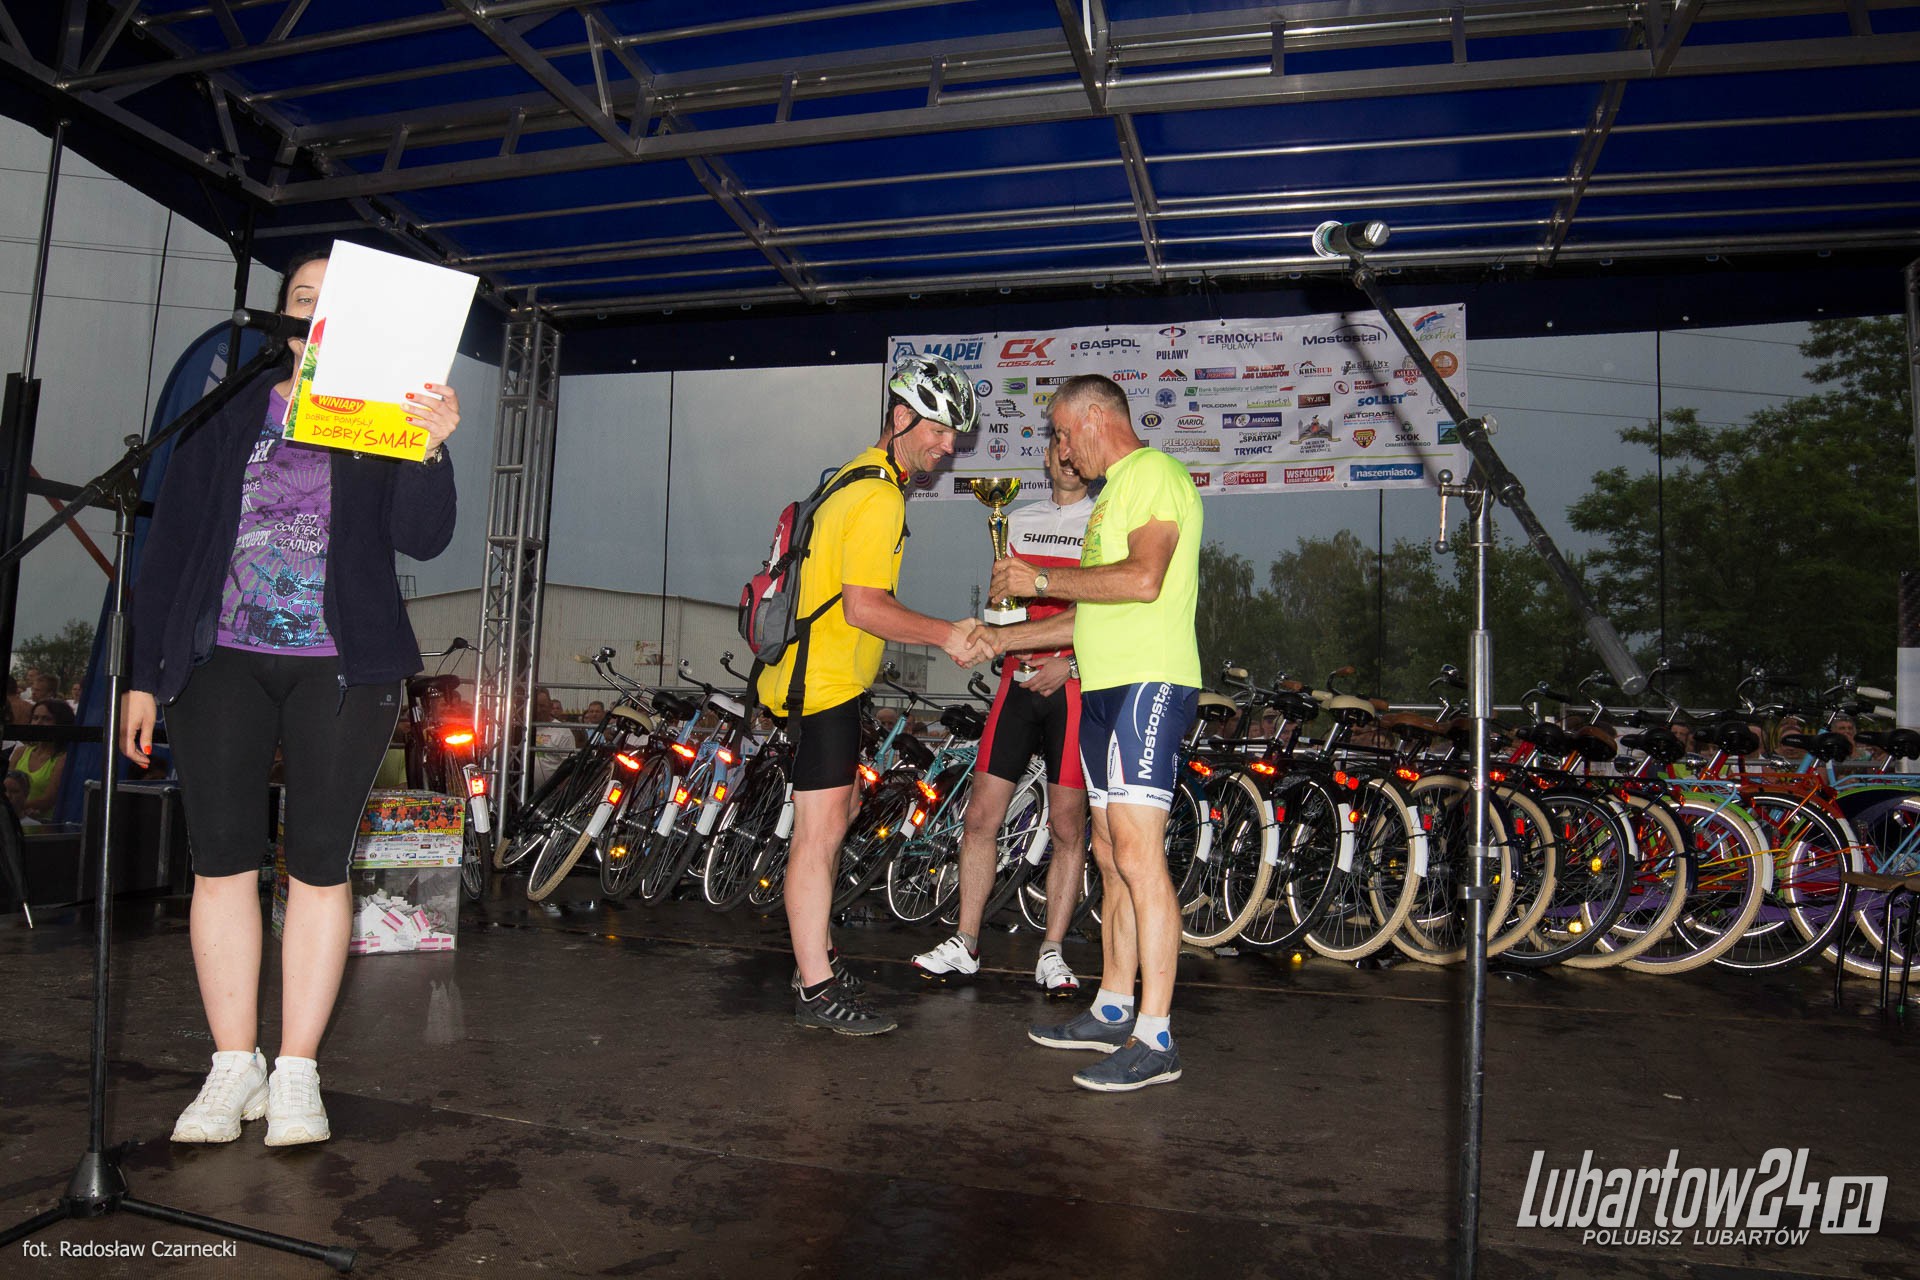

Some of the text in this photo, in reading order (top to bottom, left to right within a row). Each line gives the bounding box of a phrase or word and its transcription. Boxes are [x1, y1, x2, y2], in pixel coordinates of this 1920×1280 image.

[1198, 331, 1284, 345] TERMOCHEM
[1302, 331, 1381, 346] Mostostal
[1080, 338, 1141, 350] GASPOL
[1221, 341, 1257, 351] PUŁAWY
[923, 341, 983, 362] MAPEI
[1156, 349, 1189, 361] PUŁAWY
[996, 359, 1056, 368] COSSACK
[1048, 376, 1070, 385] SATUR
[1112, 369, 1148, 382] OLIMP
[318, 395, 364, 411] WINIARY
[1357, 394, 1405, 407] SOLBET
[305, 413, 330, 422] DOBRE
[1251, 416, 1280, 424] MRÓWKA
[1343, 410, 1395, 420] NETGRAPH
[988, 423, 1009, 434] MTS
[312, 424, 424, 449] DOBRY SMAK
[1394, 434, 1420, 442] SKOK
[1161, 438, 1221, 447] PIEKARNIA
[1234, 445, 1273, 456] TRYKACZ
[1286, 468, 1333, 479] WSPÓLNOTA
[1356, 467, 1414, 478] naszemiasto
[293, 513, 319, 525] BEST
[275, 538, 324, 554] CENTURY
